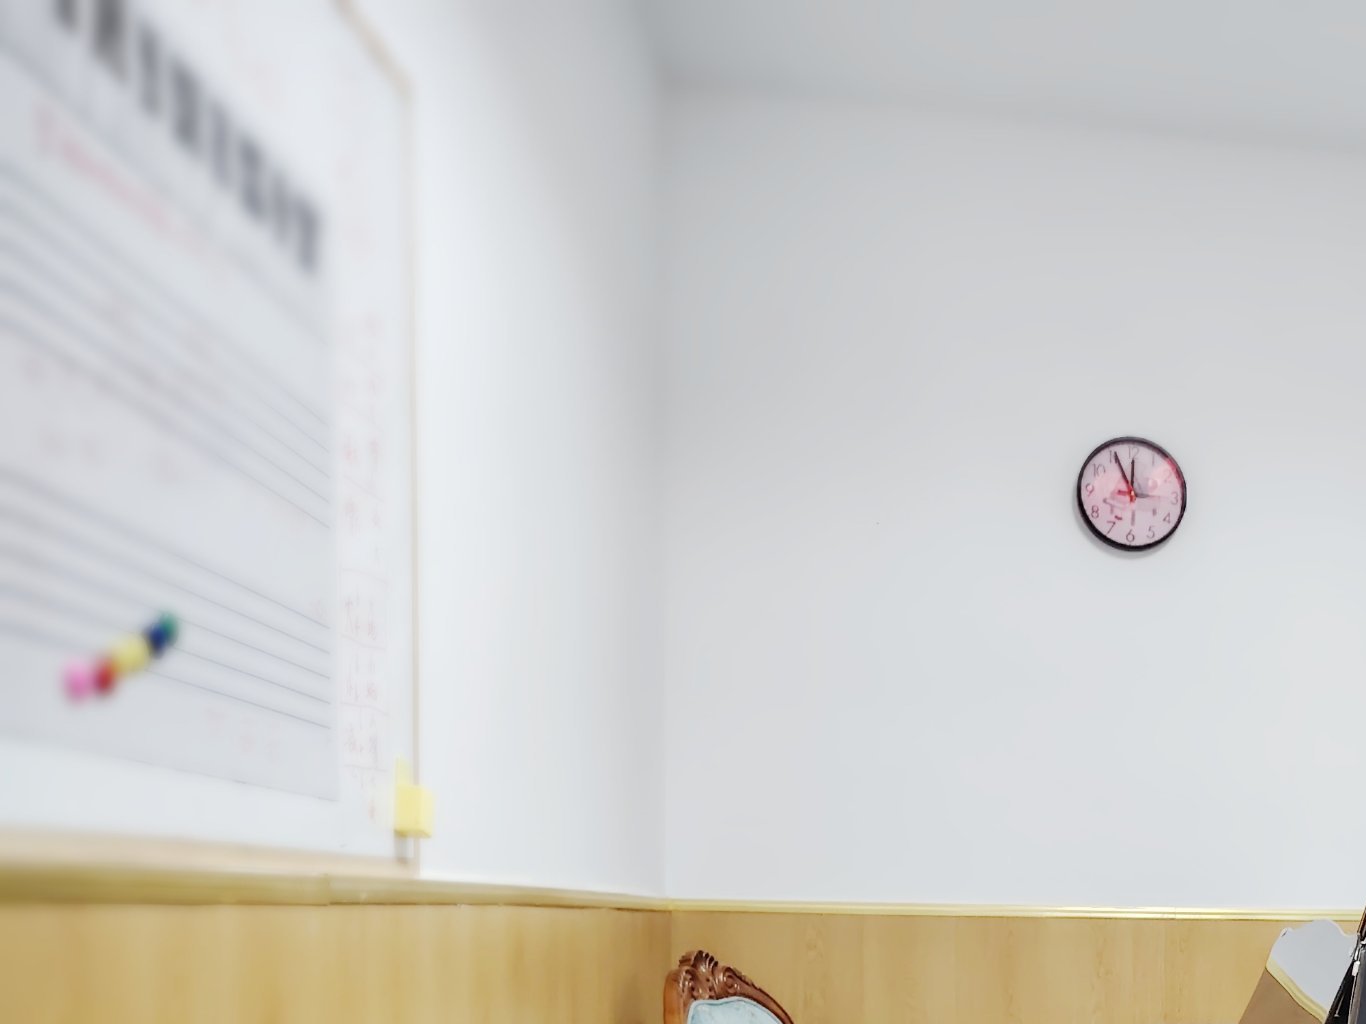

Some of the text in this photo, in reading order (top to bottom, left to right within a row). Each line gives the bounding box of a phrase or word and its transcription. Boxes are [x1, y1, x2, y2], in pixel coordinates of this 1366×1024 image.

[1128, 445, 1139, 460] 12
[1093, 463, 1106, 477] 10
[1086, 483, 1094, 497] 9
[1171, 491, 1179, 506] 3
[1091, 505, 1099, 519] 8
[1163, 512, 1171, 524] 4
[1106, 520, 1116, 535] 7
[1146, 526, 1155, 539] 5
[1126, 529, 1135, 543] 6
